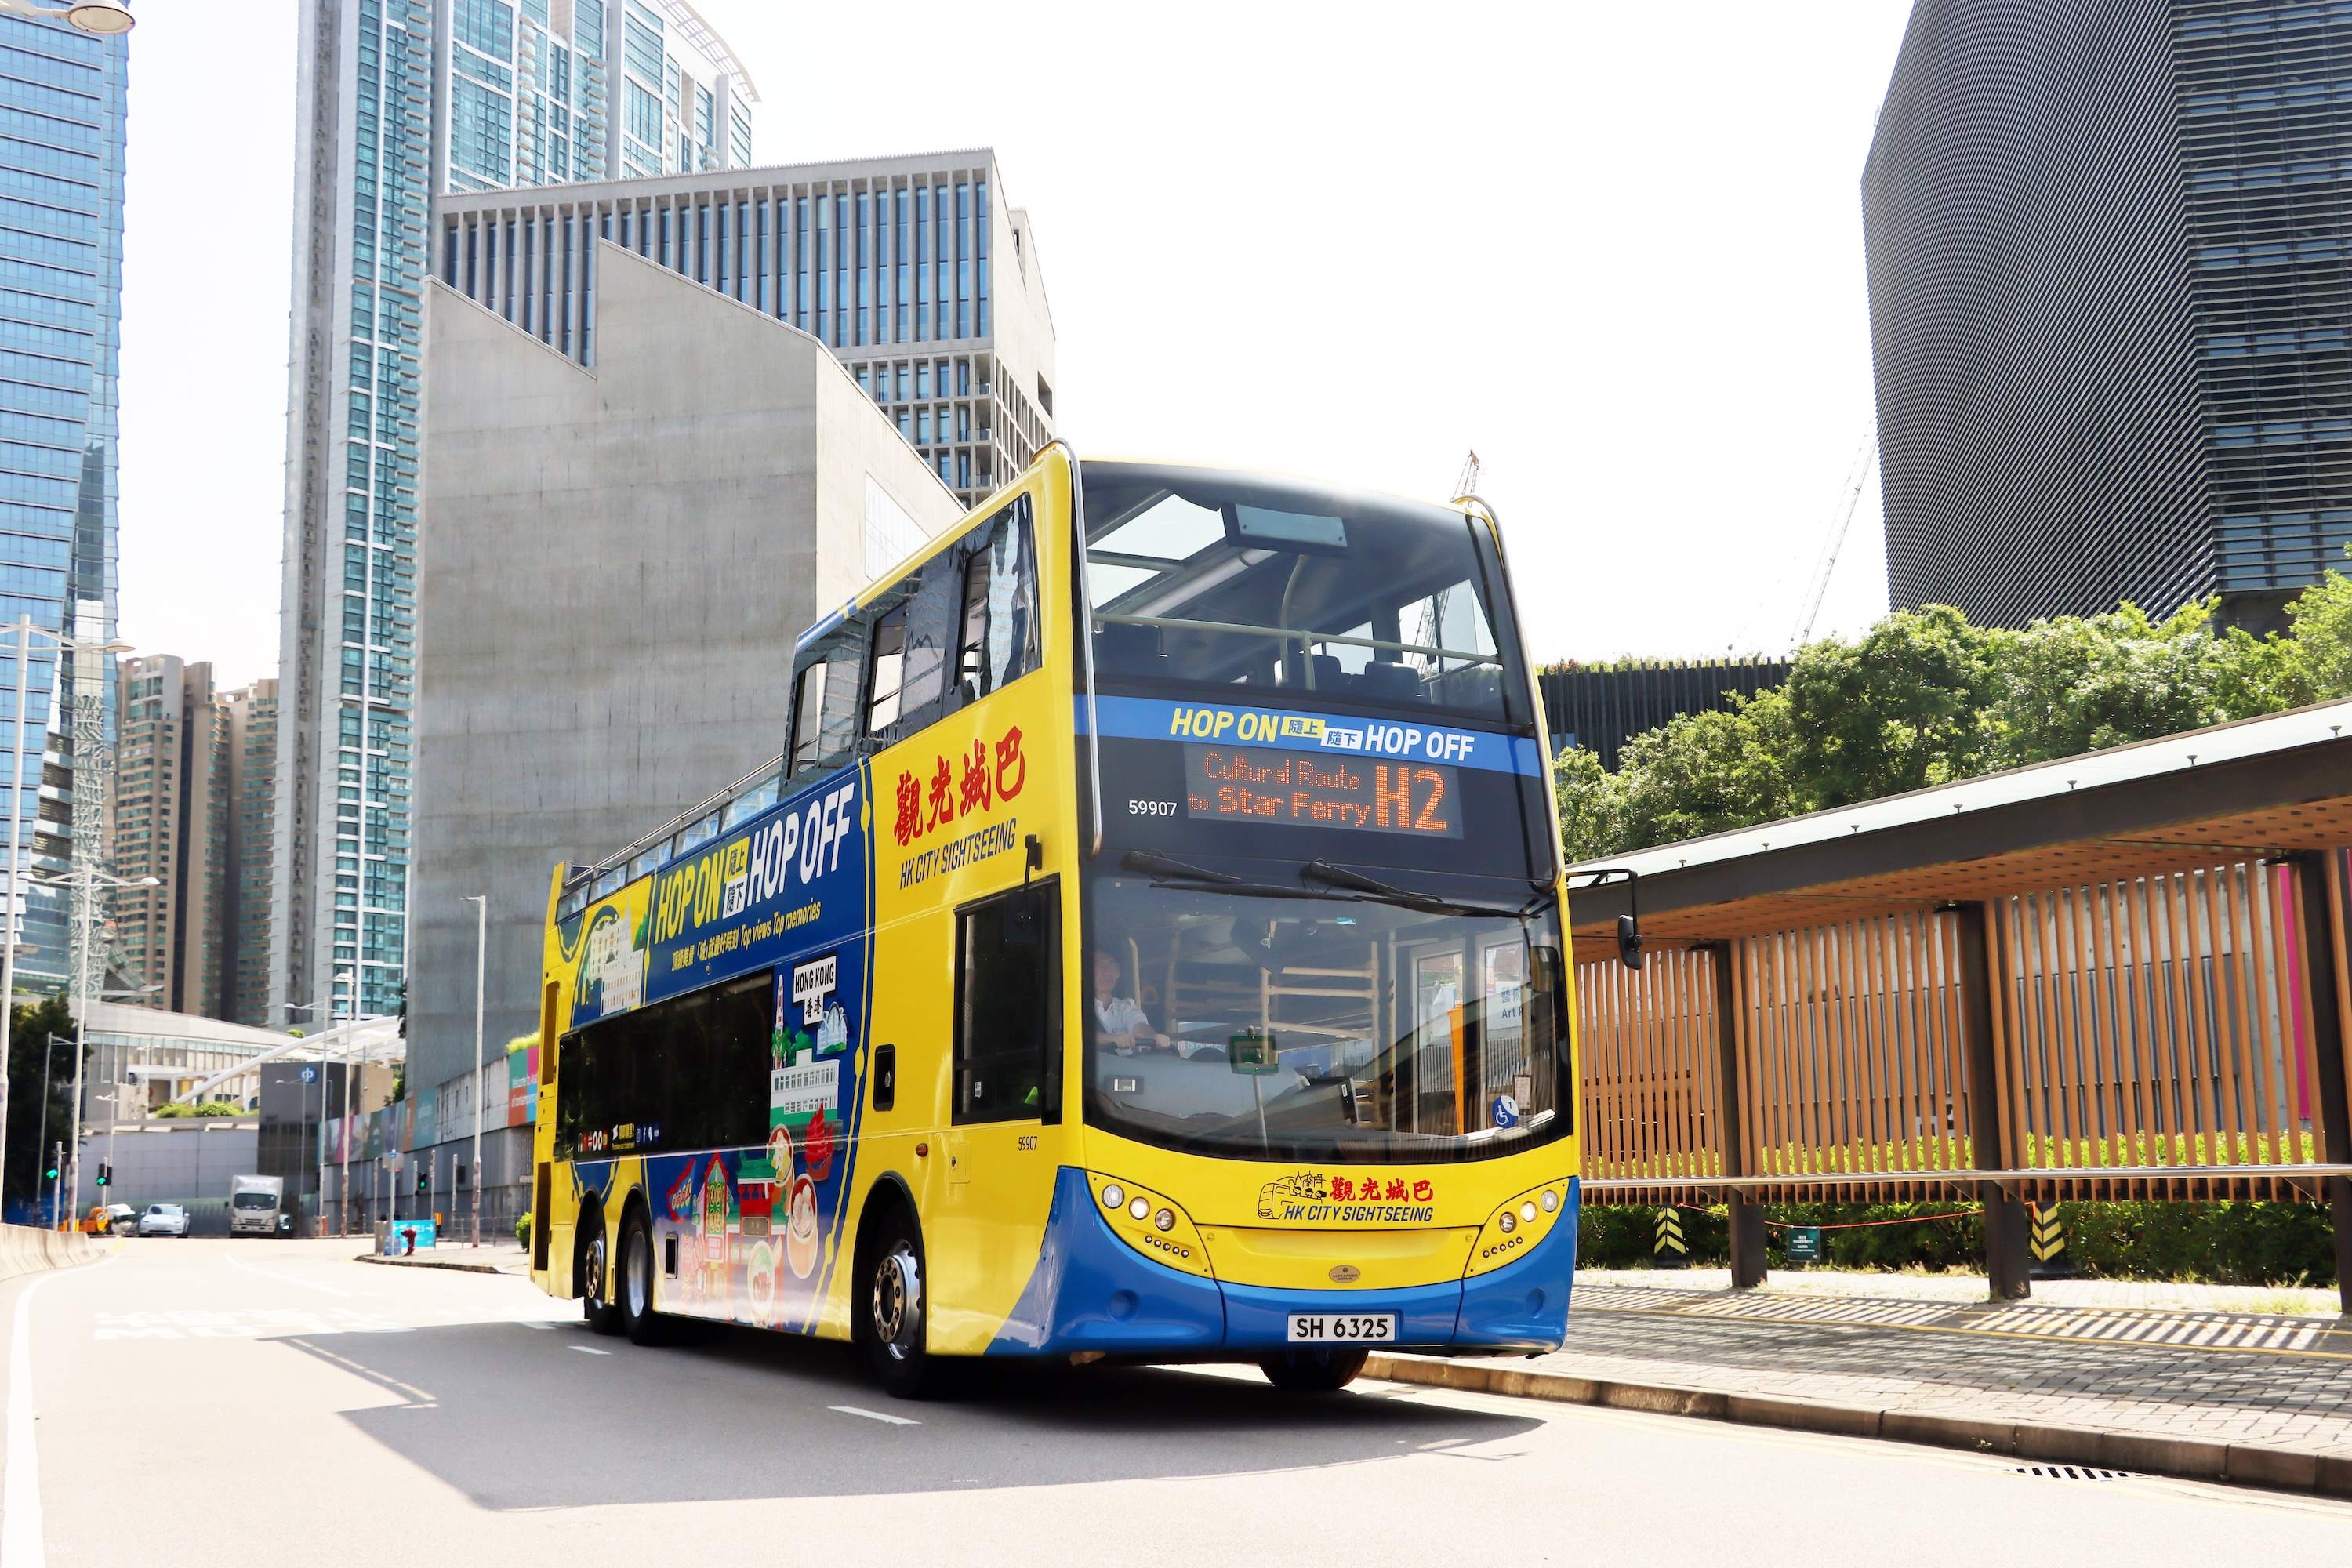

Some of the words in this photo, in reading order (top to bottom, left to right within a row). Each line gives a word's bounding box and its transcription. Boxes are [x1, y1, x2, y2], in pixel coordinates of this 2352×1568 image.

[1170, 708, 1234, 739] HOP
[1237, 713, 1279, 742] ON
[1288, 719, 1319, 735] 隨上
[1327, 731, 1358, 746] 隨下
[1364, 724, 1422, 755] HOP
[1426, 731, 1475, 761] OFF
[894, 725, 1025, 847] 觀光城巴
[1205, 753, 1290, 785] Cultural
[1298, 760, 1361, 790] Route
[1128, 800, 1178, 817] 59907
[1189, 792, 1210, 811] to
[1218, 787, 1284, 816] Star
[1292, 793, 1371, 827] Ferry
[1376, 765, 1448, 831] H2
[800, 782, 855, 884] OFF
[728, 847, 745, 878] 隨上
[747, 811, 800, 907] HOP
[899, 858, 916, 891] HK
[915, 848, 941, 884] CITY
[941, 818, 1017, 874] SIGHTSEEING
[654, 864, 695, 945] HOP
[694, 848, 725, 929] ON
[727, 881, 744, 915] 隨下
[740, 924, 753, 951] Top
[753, 919, 772, 938] views
[773, 910, 785, 939] Top
[786, 898, 821, 927] memories
[795, 969, 814, 994] HONG
[815, 963, 834, 988] KONG
[805, 994, 822, 1018] 香港
[1501, 1007, 1516, 1018] Art
[1018, 1136, 1038, 1151] 59907
[1330, 1176, 1434, 1203] 觀光城巴
[1283, 1205, 1305, 1221] HK
[1307, 1205, 1342, 1221] CITY
[1342, 1206, 1434, 1222] SIGHTSEEING
[1296, 1318, 1323, 1338] SH
[1334, 1318, 1388, 1338] 6325
